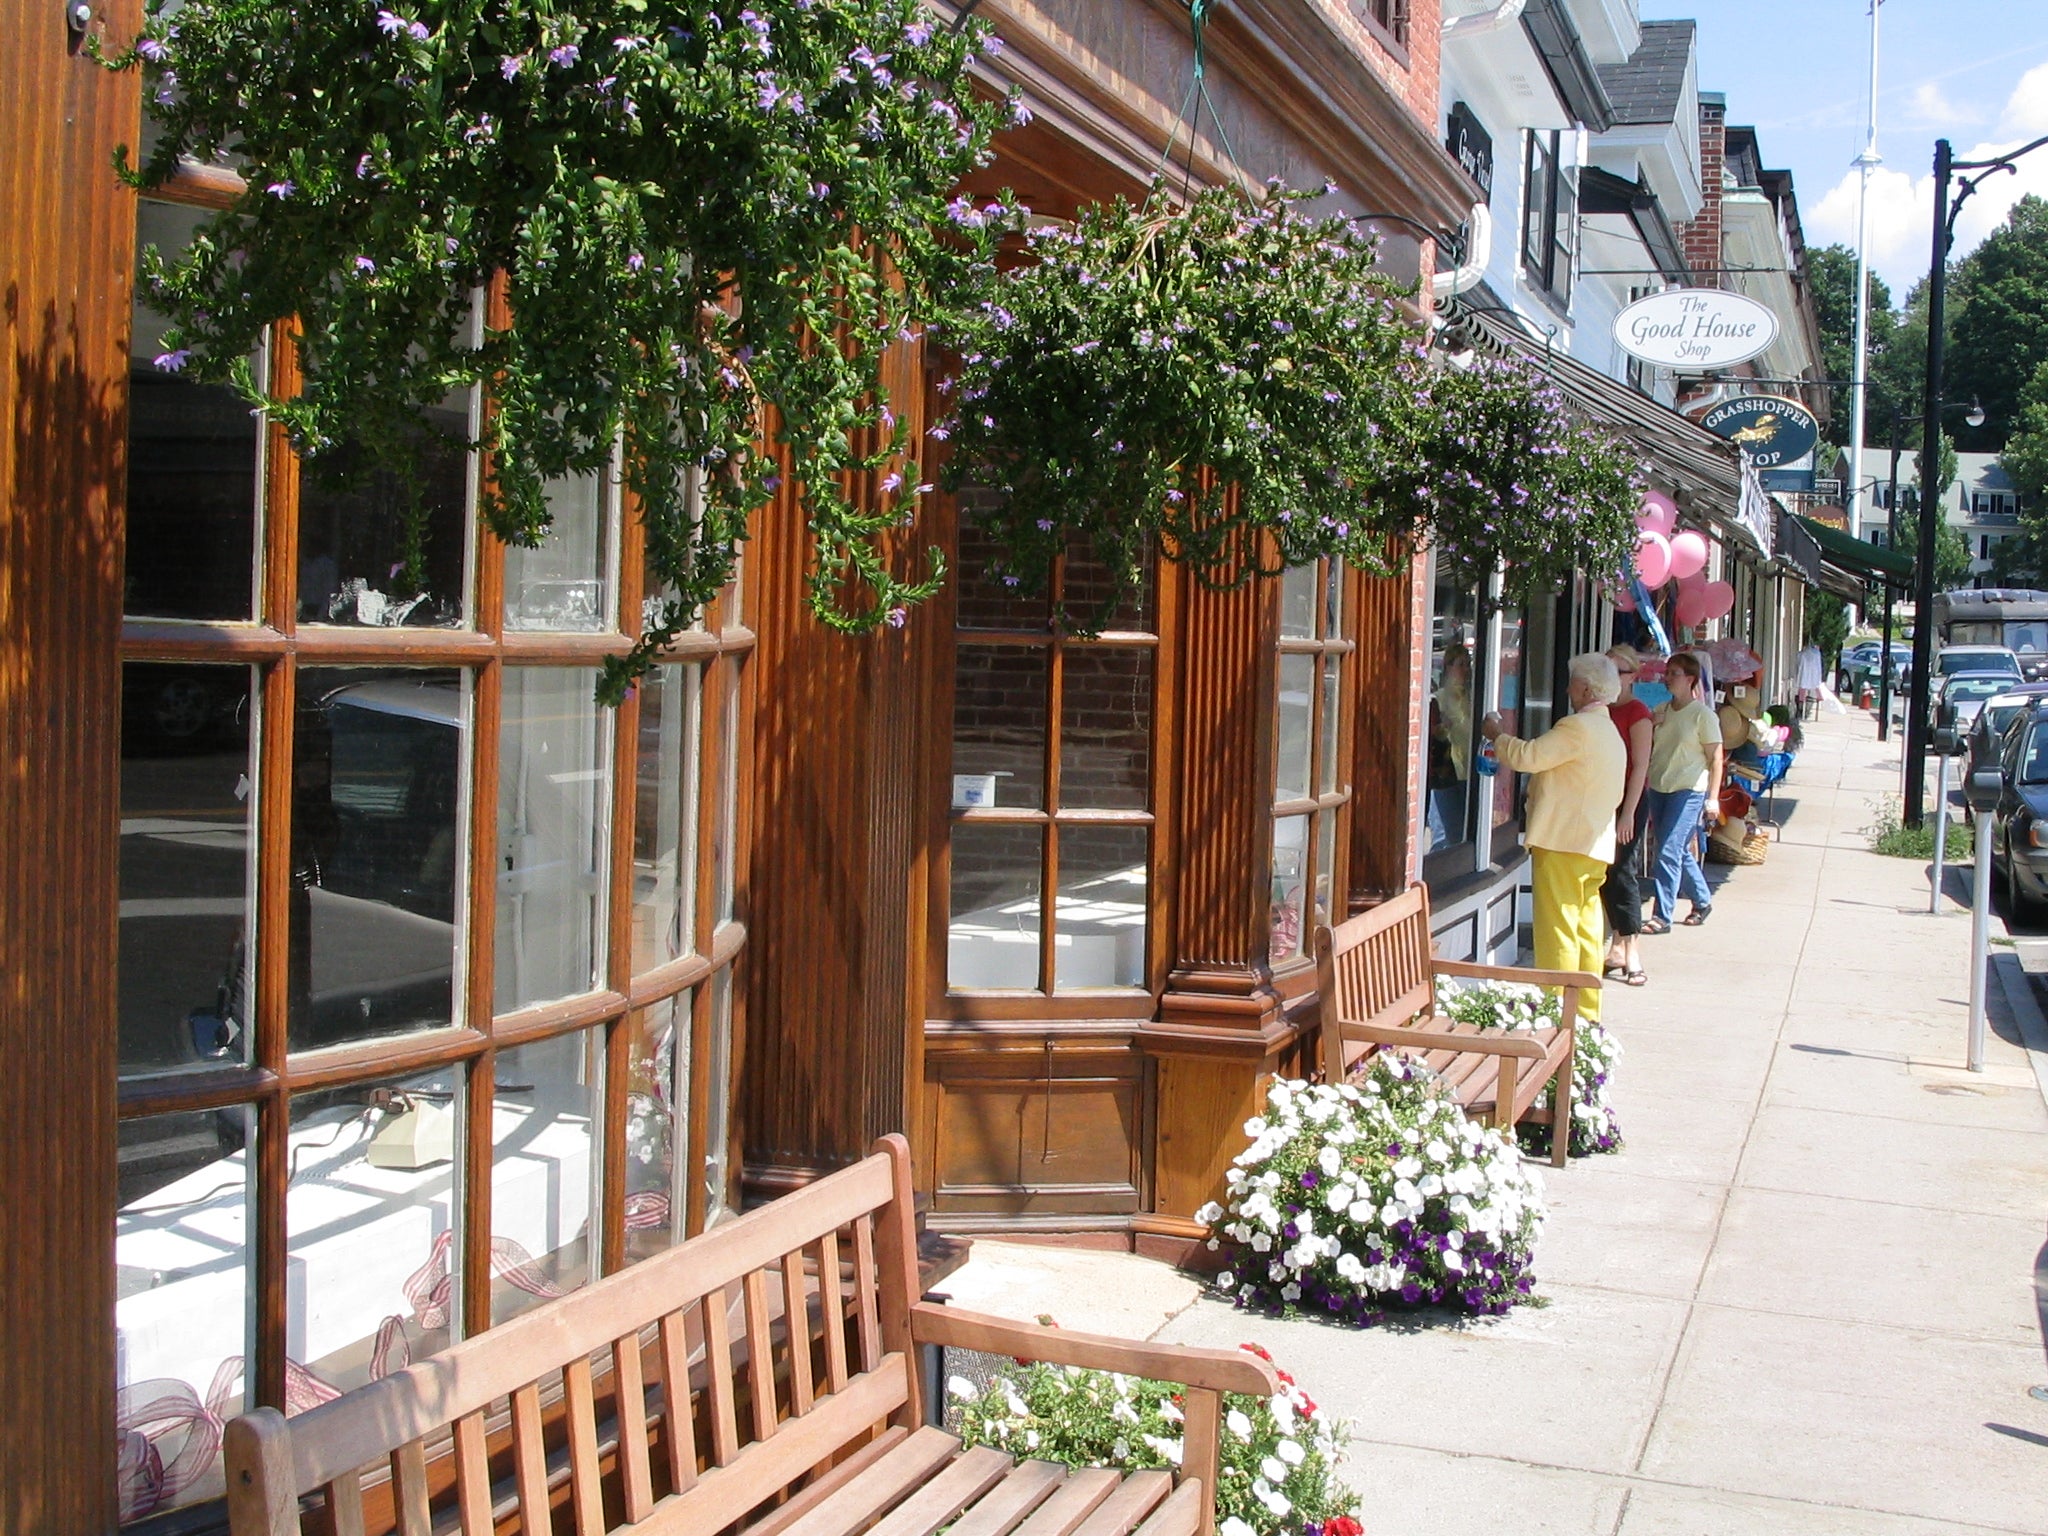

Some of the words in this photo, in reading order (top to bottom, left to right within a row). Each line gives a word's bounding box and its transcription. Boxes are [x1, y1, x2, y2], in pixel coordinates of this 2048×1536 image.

[1679, 296, 1708, 313] The
[1631, 315, 1687, 346] Good
[1693, 312, 1757, 338] House
[1674, 340, 1712, 361] Shop
[1705, 399, 1811, 430] GRASSHOPPER
